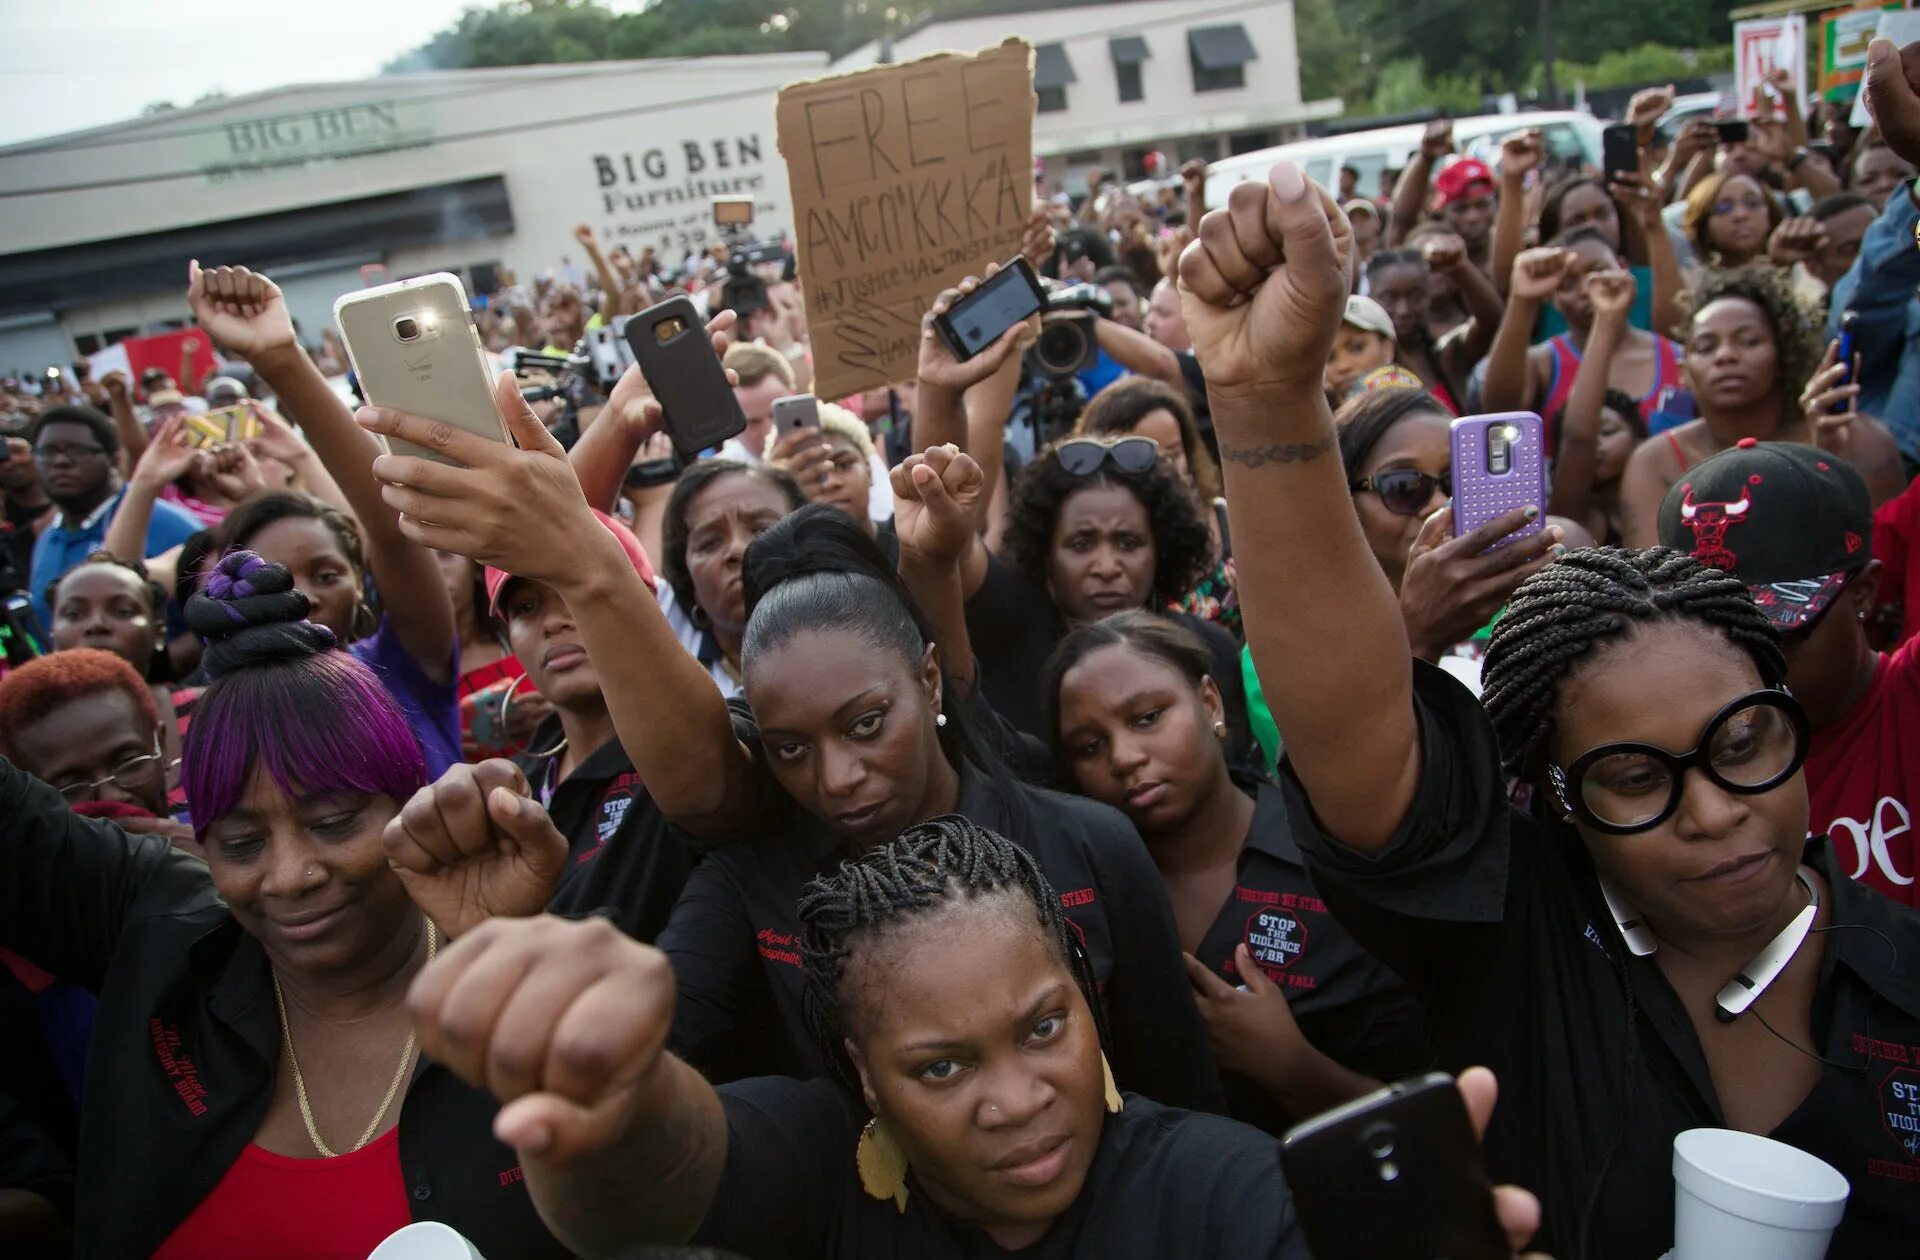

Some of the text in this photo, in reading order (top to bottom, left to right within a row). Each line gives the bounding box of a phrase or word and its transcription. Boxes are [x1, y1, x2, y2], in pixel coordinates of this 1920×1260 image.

[223, 100, 397, 154] BIG BEN
[804, 56, 1009, 200] FREE
[593, 133, 763, 188] BIG BEN
[602, 174, 764, 214] Furniture
[603, 797, 632, 814] STOP
[1061, 888, 1095, 907] STAND
[1282, 894, 1298, 907] WE
[1259, 914, 1296, 932] STOP
[1249, 933, 1301, 954] VIOLENCE
[1267, 928, 1288, 940] THE
[1255, 948, 1285, 964] of BR
[1288, 974, 1316, 989] FALL
[175, 1080, 208, 1117] BOARD
